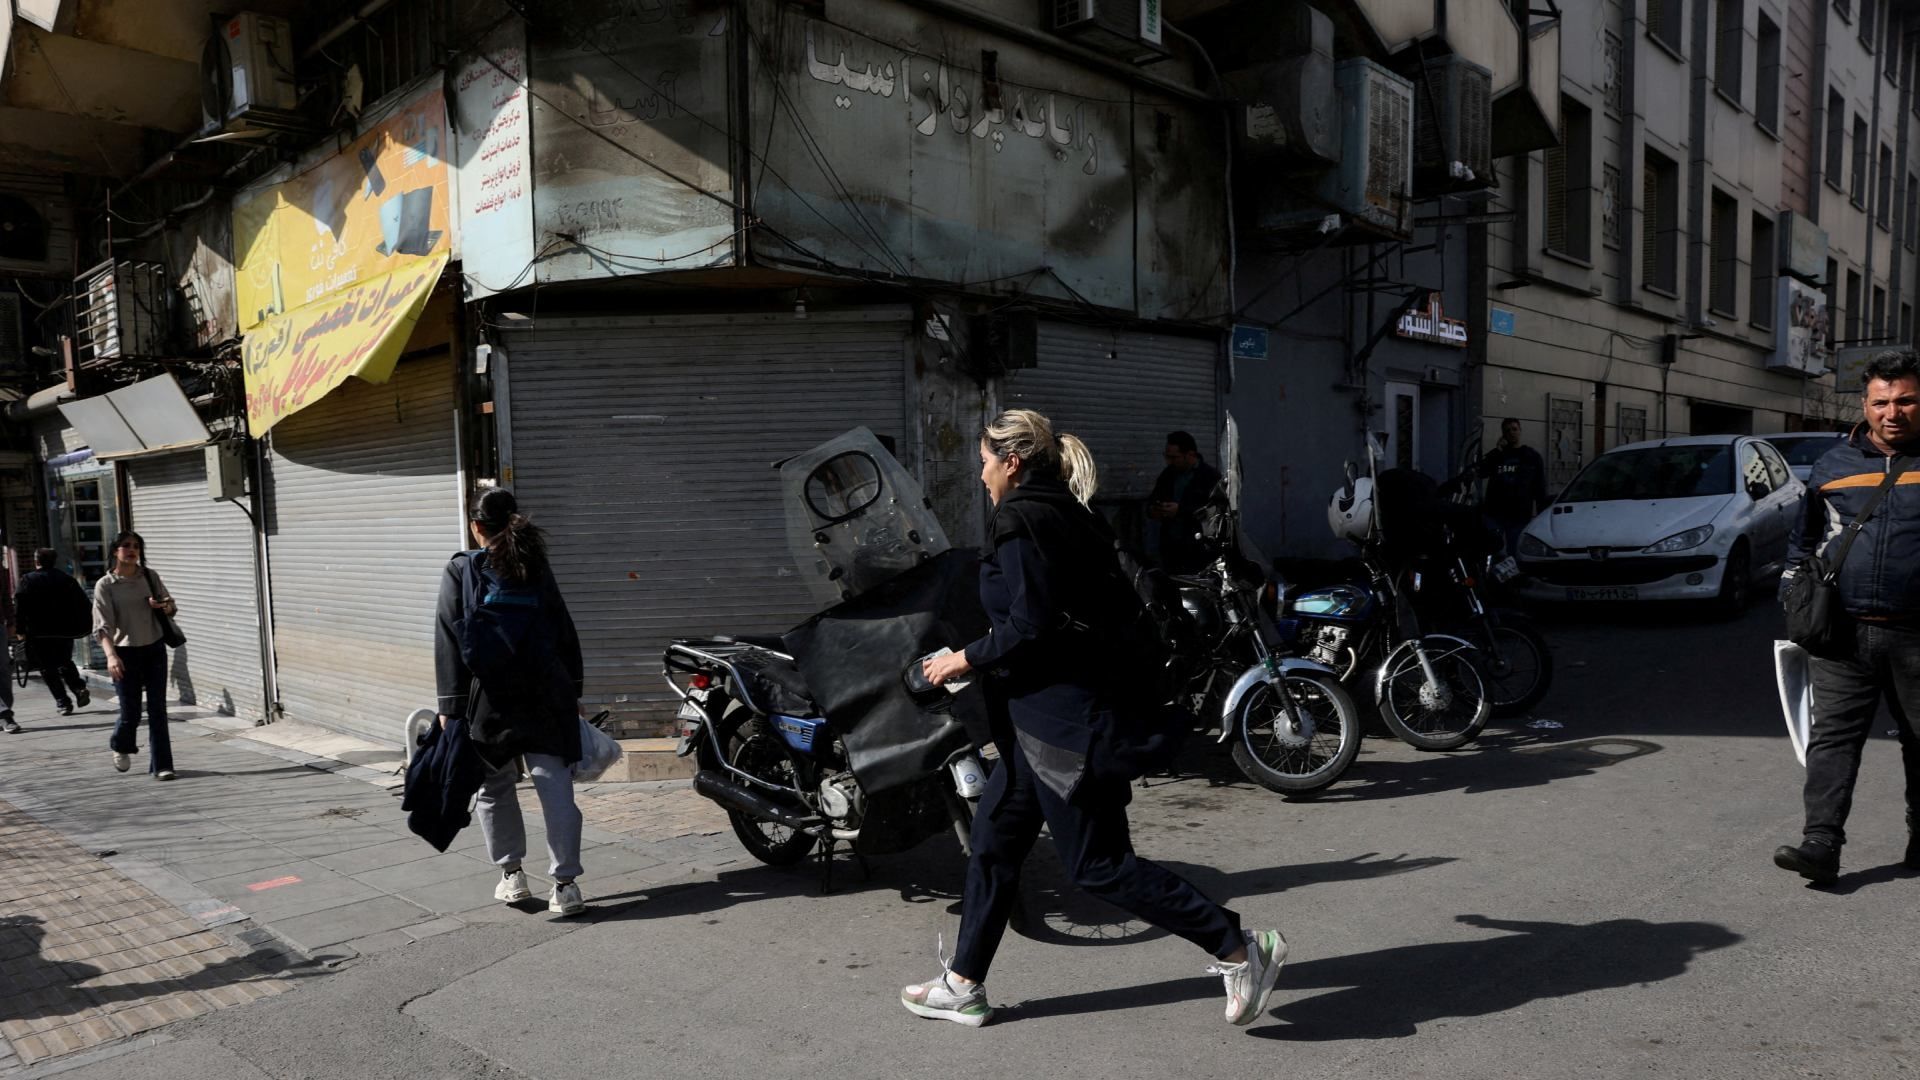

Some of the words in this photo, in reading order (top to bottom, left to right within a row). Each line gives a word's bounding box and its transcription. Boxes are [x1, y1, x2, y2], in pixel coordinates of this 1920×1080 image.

[806, 18, 920, 110] آسیا
[588, 70, 680, 138] آسیا
[916, 54, 1006, 153] پرداز
[1012, 89, 1098, 175] رایانه
[501, 134, 521, 152] خدمات
[506, 160, 521, 179] فروش
[293, 287, 365, 356] تخصصی
